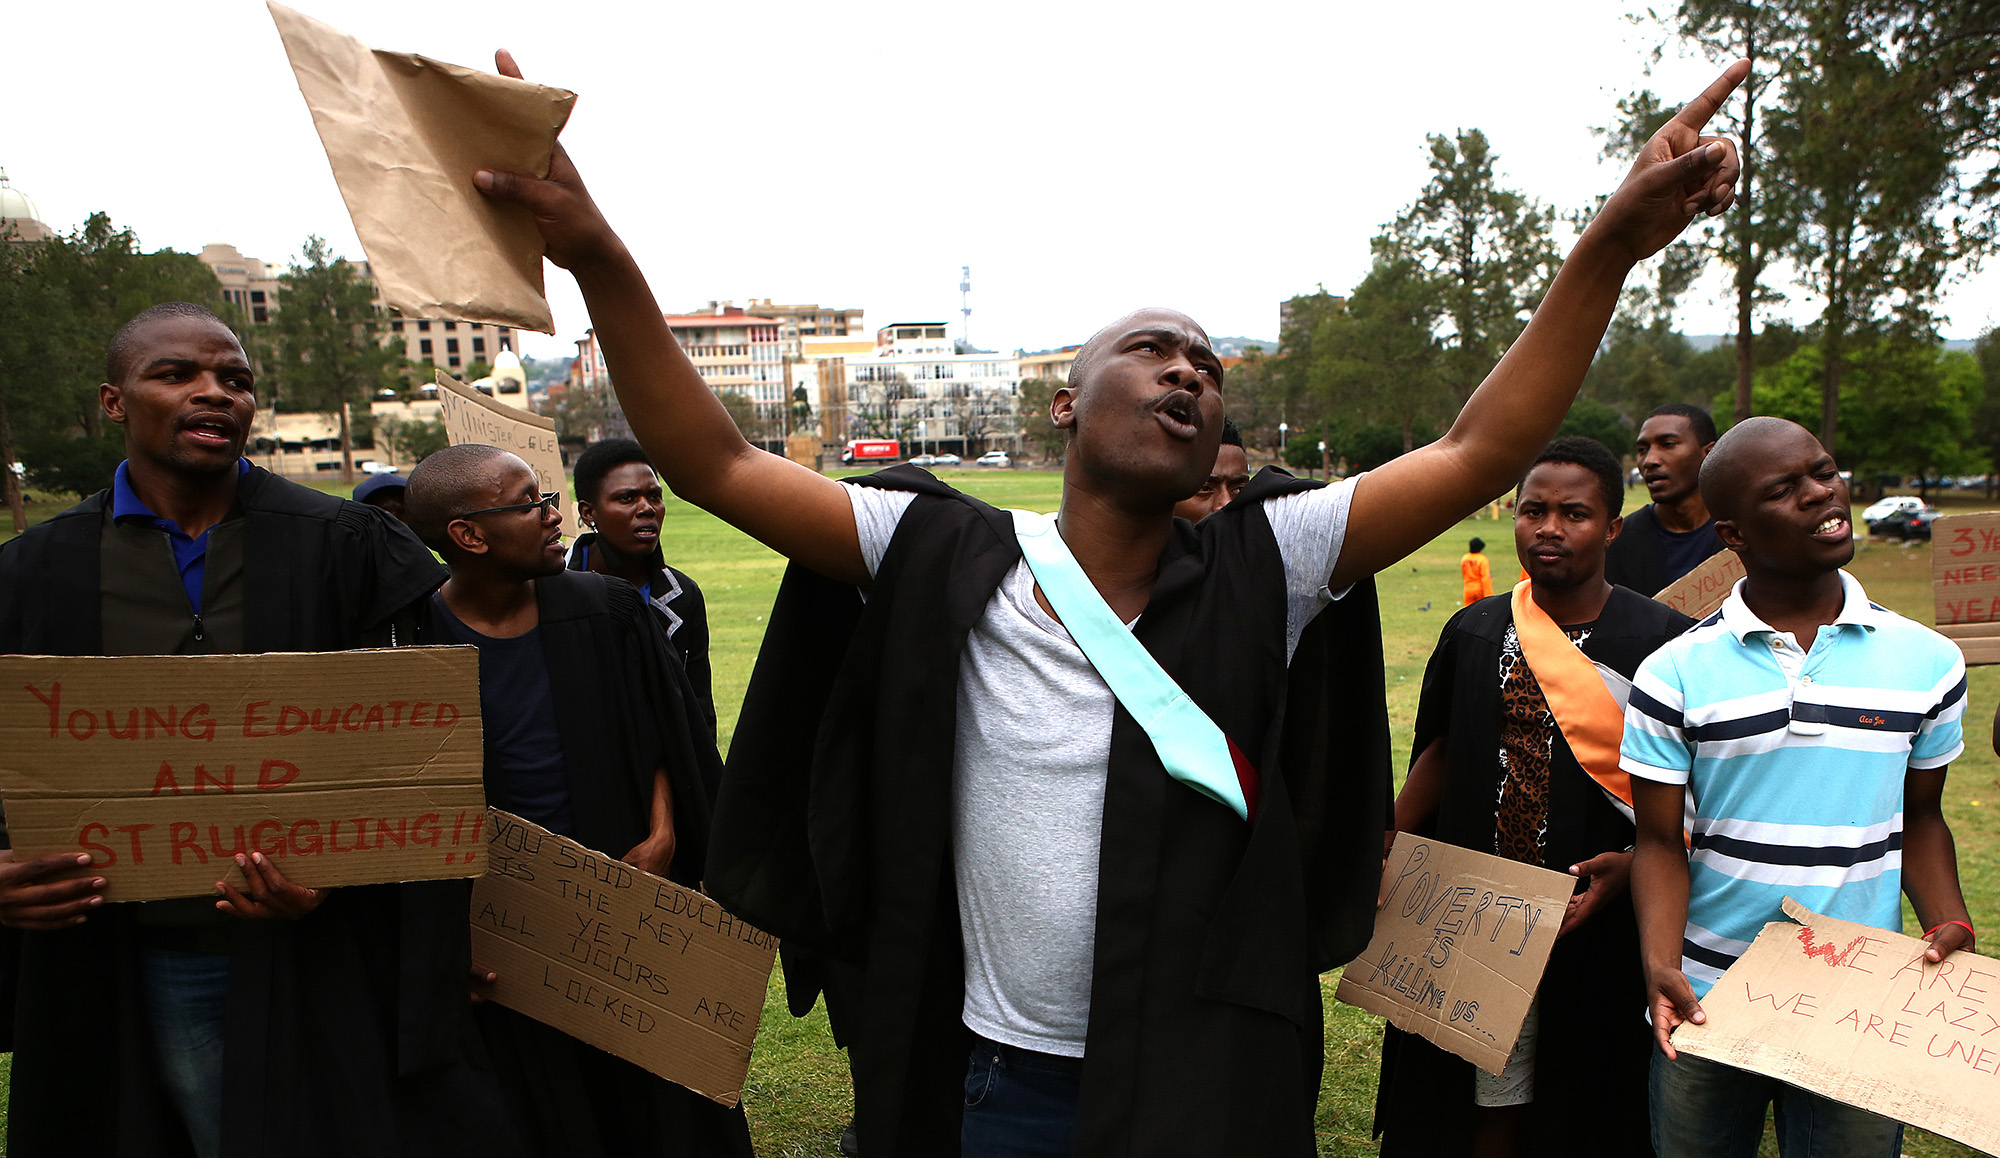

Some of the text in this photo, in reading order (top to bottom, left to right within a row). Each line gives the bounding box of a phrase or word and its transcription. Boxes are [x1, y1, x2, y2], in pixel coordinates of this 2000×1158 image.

[1949, 527, 1976, 557] 3
[1943, 564, 2000, 587] NEE
[24, 681, 460, 742] YOUNG EDUCATED
[150, 759, 300, 798] AND
[78, 811, 484, 869] STRUGGLING!!
[490, 815, 776, 951] YOU SAID EDUCATION
[495, 855, 694, 954] IS THE KEY
[1379, 843, 1542, 956] POVERTY
[575, 911, 638, 954] YET
[478, 901, 746, 1032] ALL DOORS ARE
[1796, 926, 1998, 1005] WE ARE
[543, 964, 656, 1034] LOCKED
[1745, 982, 2000, 1075] WE ARE UNE
[1901, 991, 2000, 1037] LAZY
